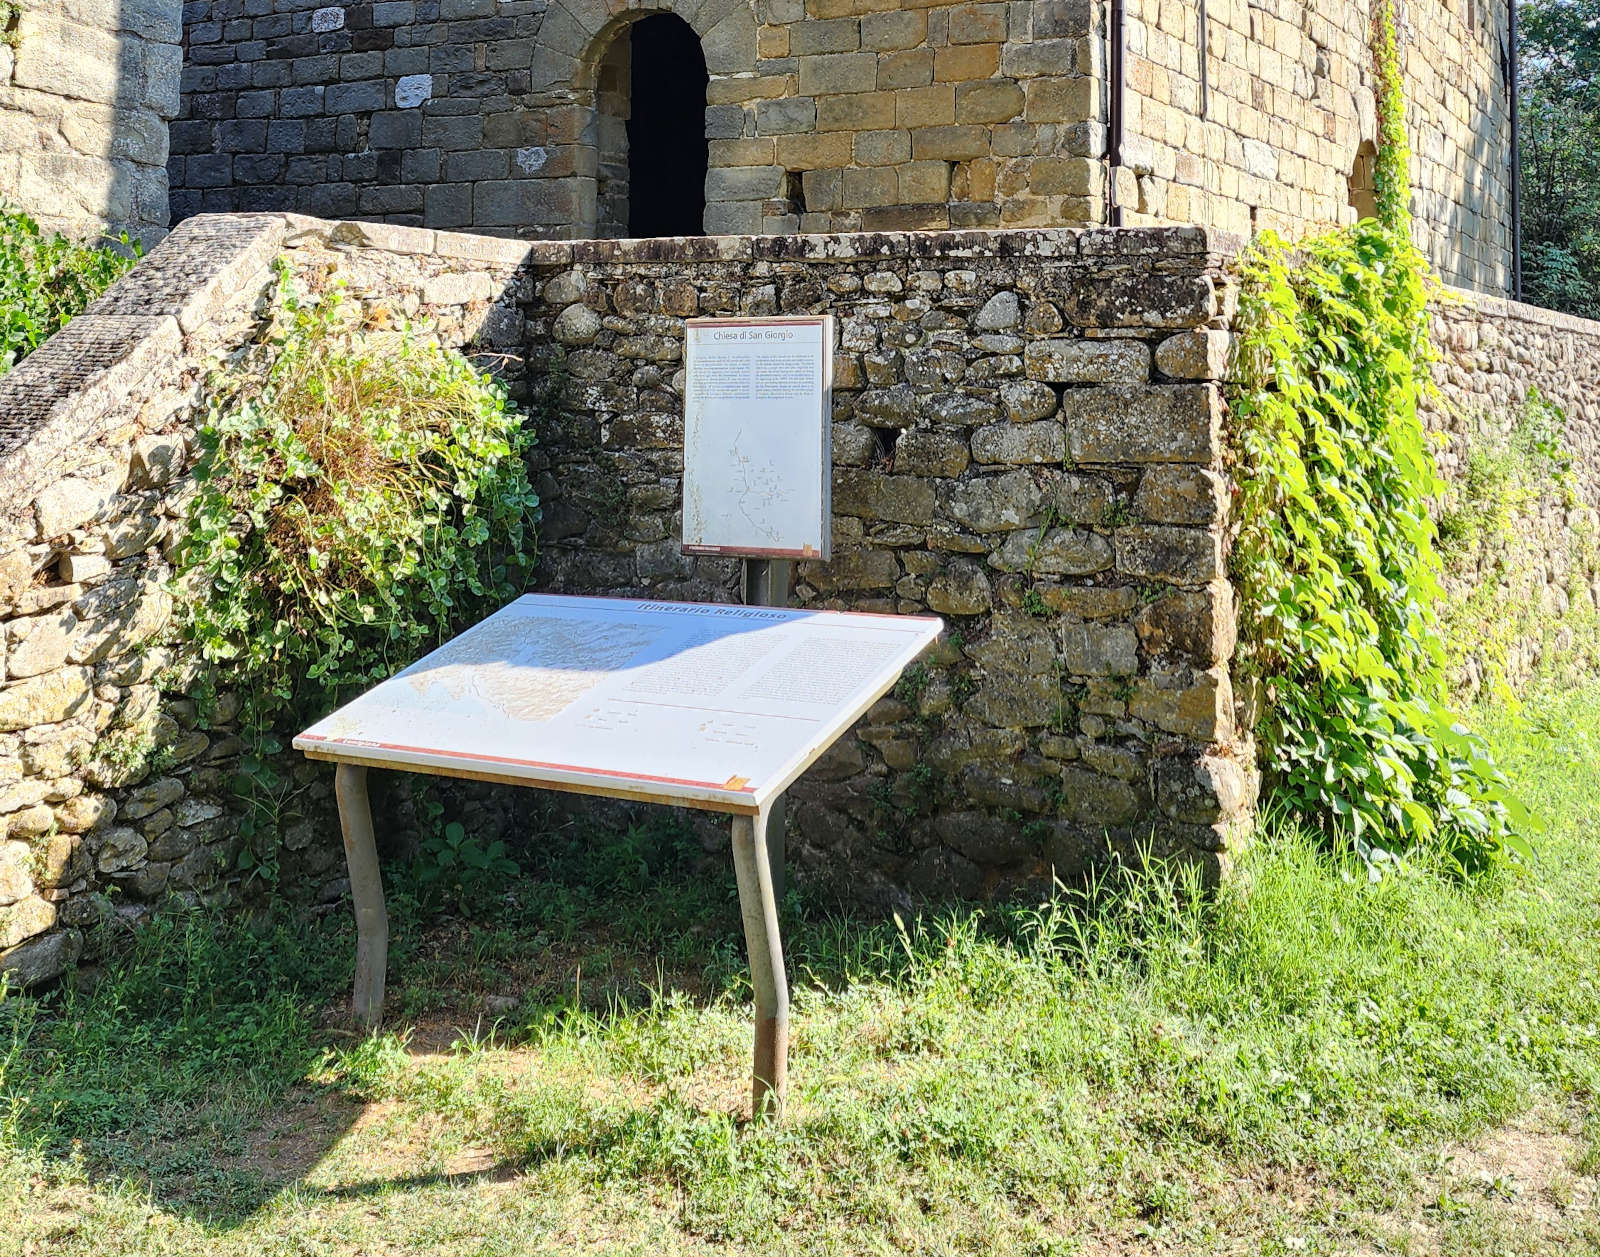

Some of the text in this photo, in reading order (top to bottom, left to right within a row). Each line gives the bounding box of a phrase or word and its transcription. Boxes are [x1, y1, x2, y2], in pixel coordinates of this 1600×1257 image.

[713, 329, 794, 341] Chiesa di San Giorgio
[637, 603, 787, 619] Itinerario Religioso
